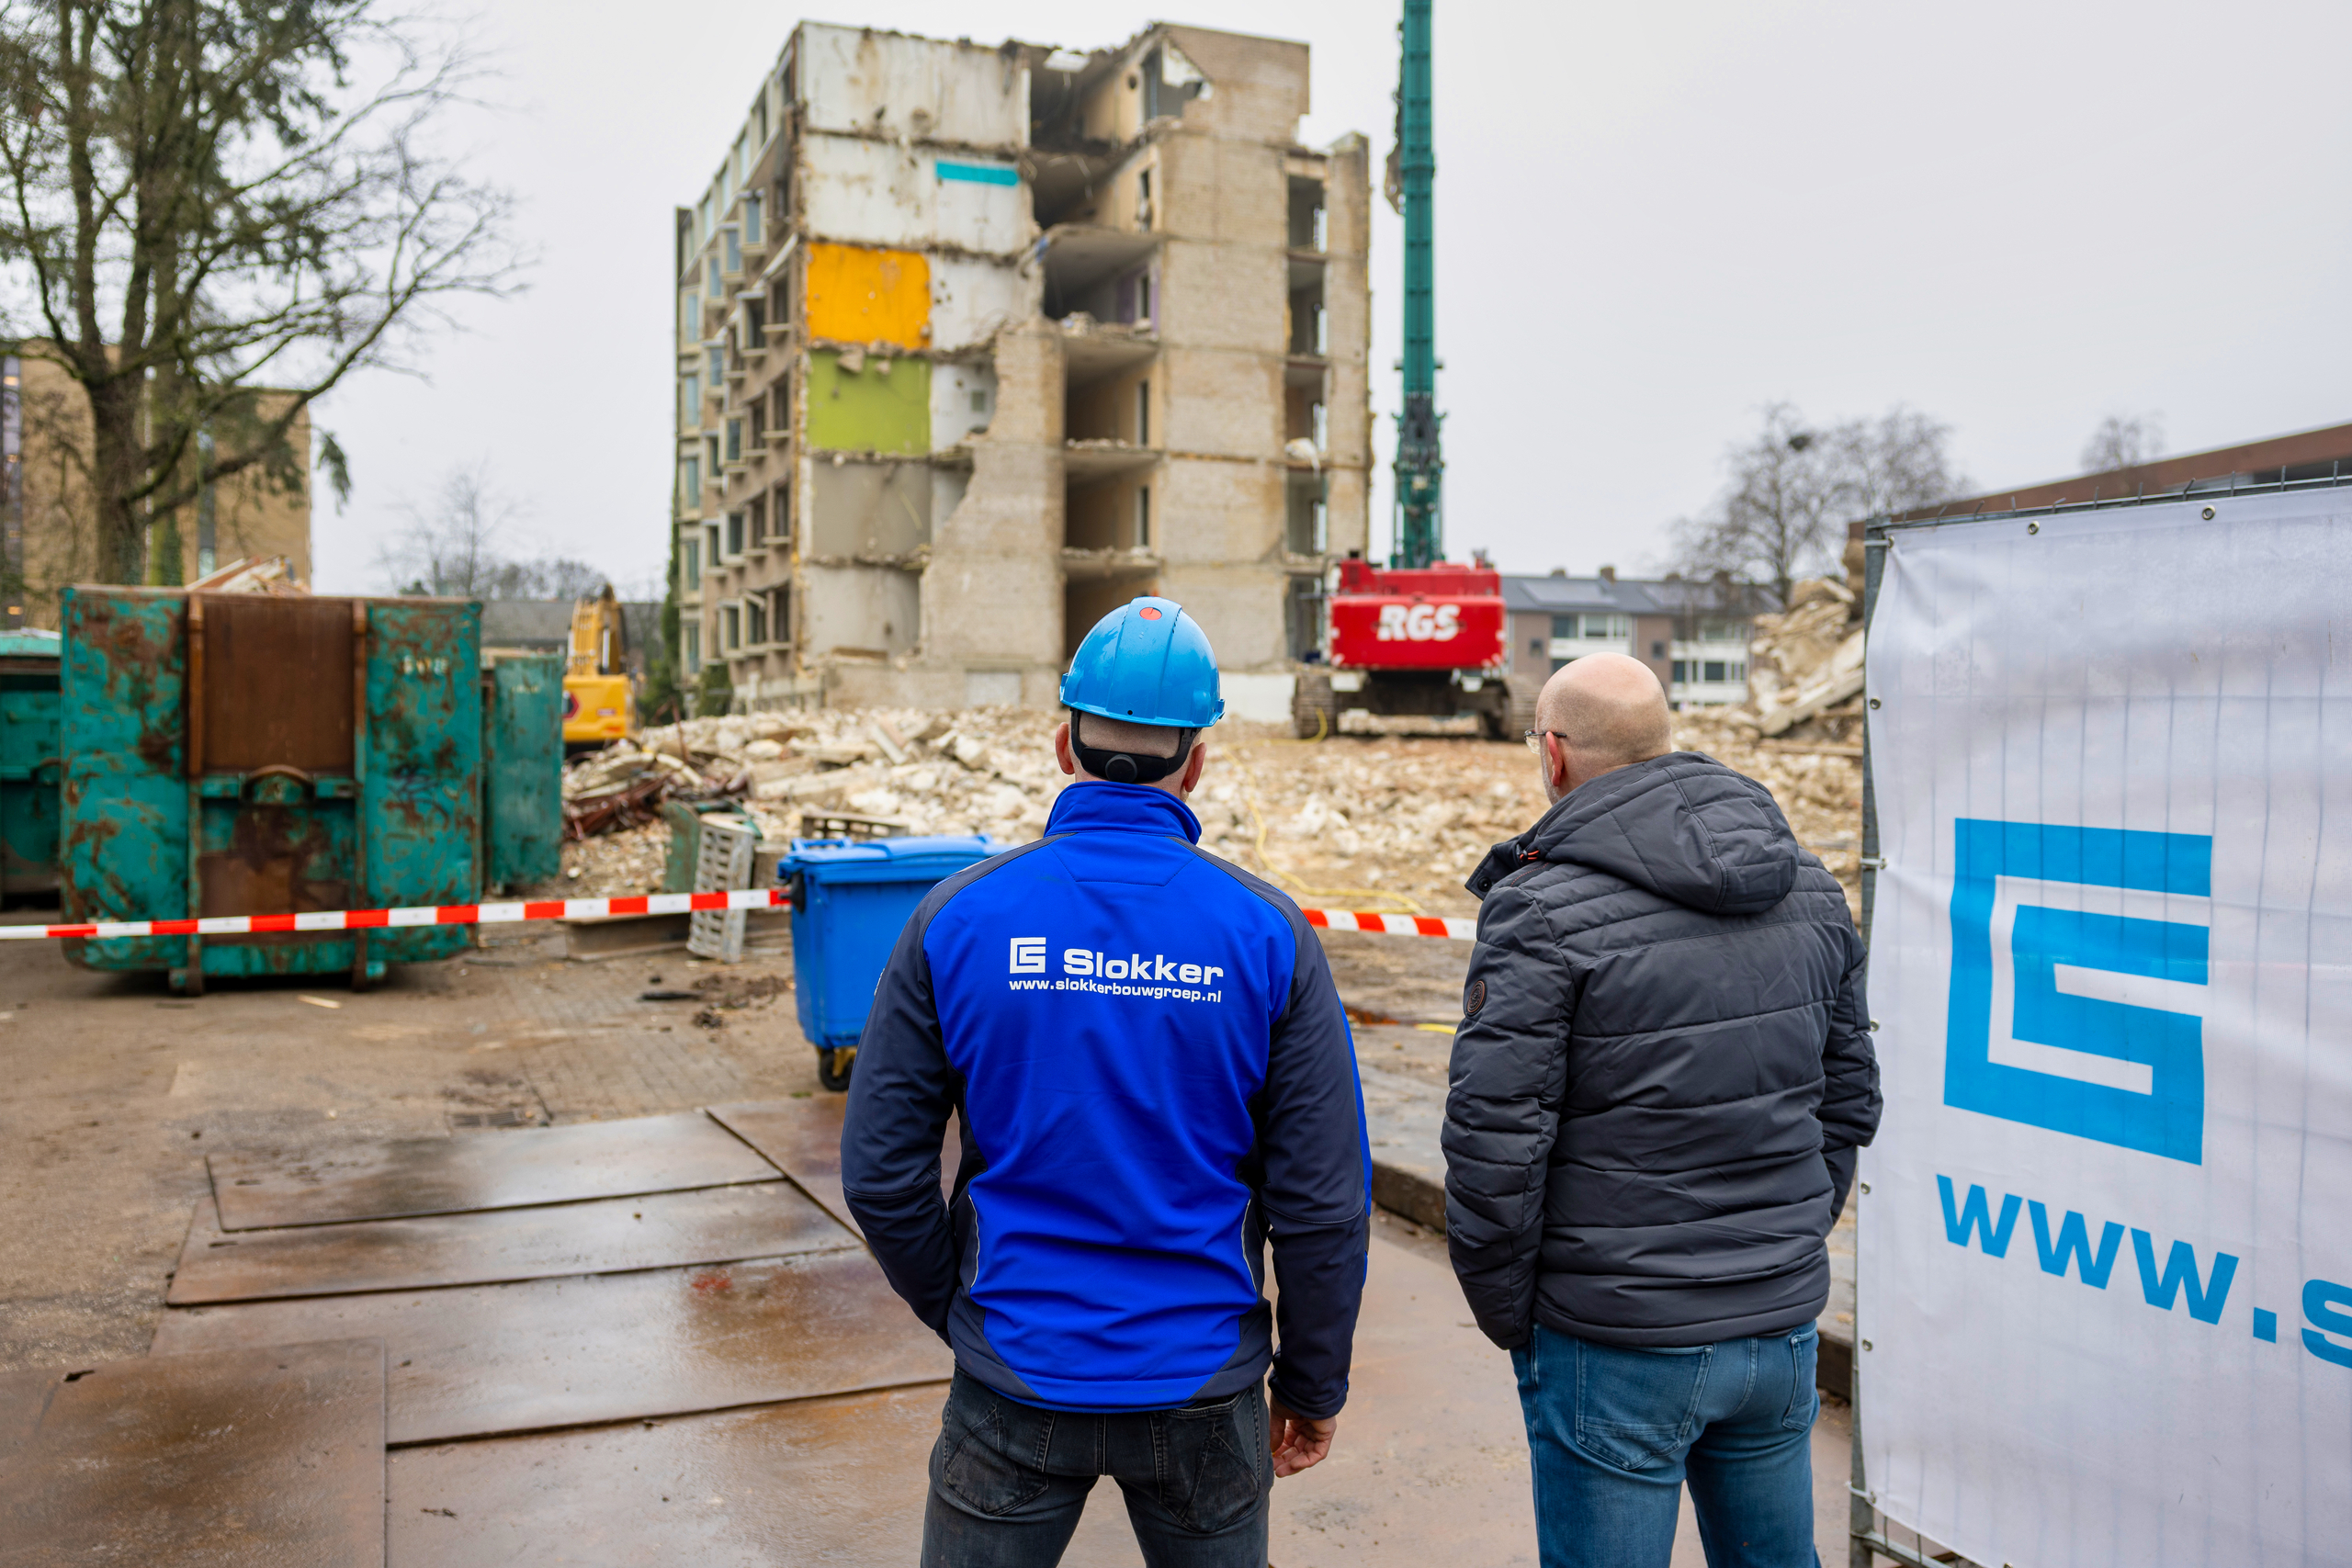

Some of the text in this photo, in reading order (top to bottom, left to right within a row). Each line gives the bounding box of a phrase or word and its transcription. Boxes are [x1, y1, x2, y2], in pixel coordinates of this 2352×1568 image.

[1377, 604, 1460, 641] RGS
[1063, 948, 1224, 986] Slokker
[1009, 977, 1222, 1003] www.slokkerbouwgroep.nl
